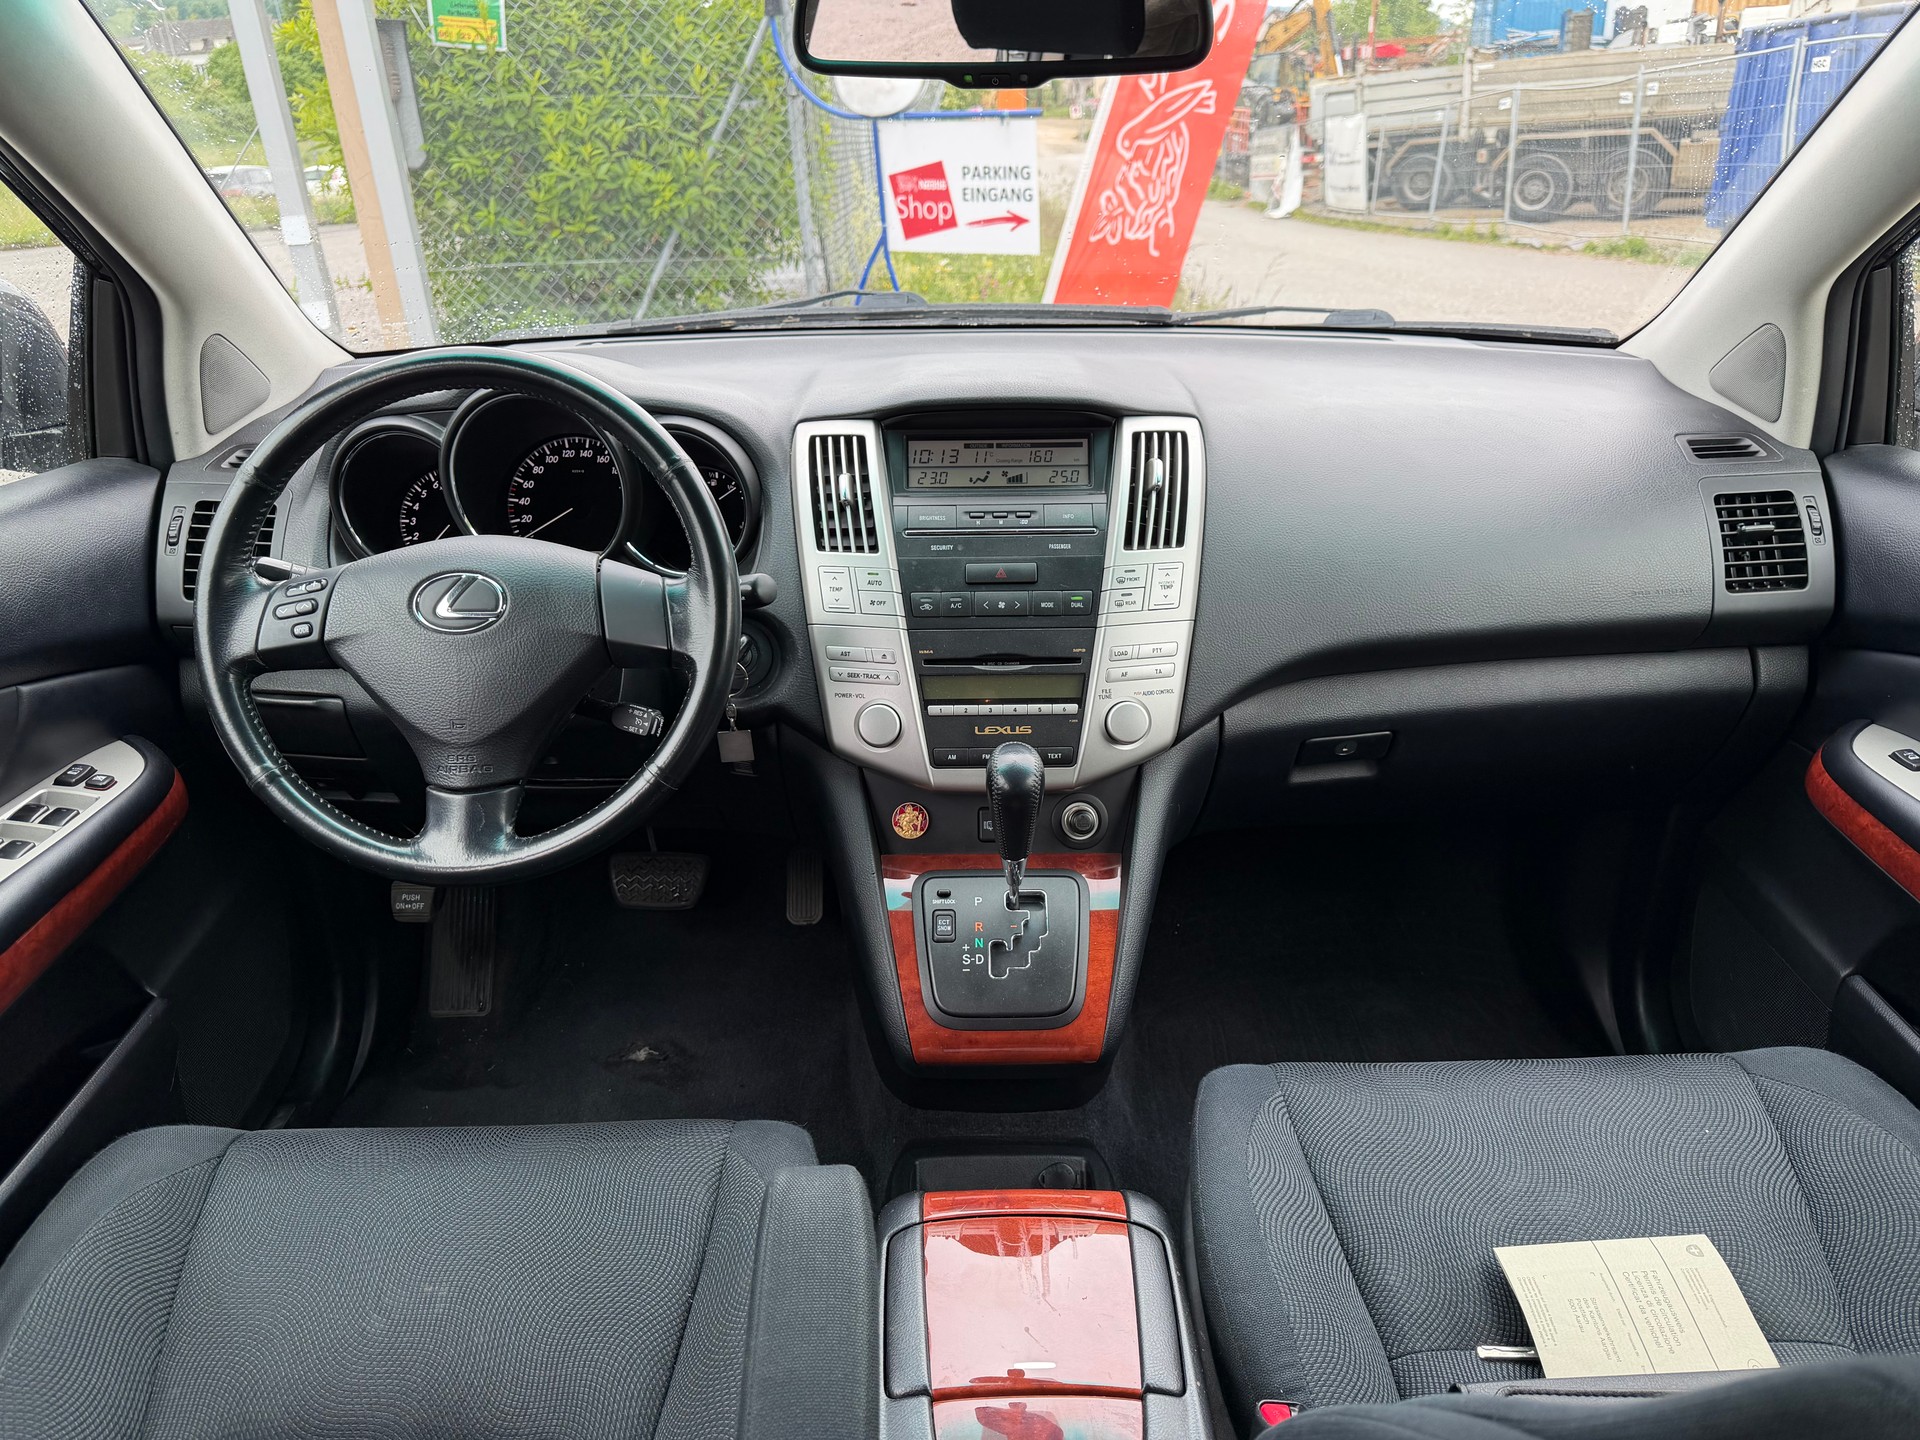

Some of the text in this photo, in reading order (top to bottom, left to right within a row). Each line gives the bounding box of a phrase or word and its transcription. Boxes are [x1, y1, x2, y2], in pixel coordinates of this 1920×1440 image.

[962, 166, 1031, 180] PARKING
[962, 188, 1034, 202] EINGANG
[895, 194, 953, 226] Shop
[562, 449, 576, 458] 120
[580, 449, 593, 458] 140
[912, 449, 960, 464] 10:13
[1028, 449, 1054, 463] 160
[545, 455, 559, 464] 100
[596, 455, 610, 464] 160
[532, 466, 544, 474] 80
[432, 480, 439, 489] 6
[522, 480, 534, 489] 60
[420, 489, 427, 498] 5
[518, 497, 531, 506] 40
[412, 502, 420, 511] 4
[410, 517, 417, 526] 3
[521, 514, 532, 523] 20
[412, 532, 420, 541] 2
[974, 725, 1033, 735] LEXUS
[436, 764, 494, 774] AIRBAG
[402, 893, 421, 901] PUSH
[974, 896, 983, 906] P
[395, 902, 425, 910] ON OFF
[975, 922, 984, 932] R
[975, 938, 984, 948] N
[1567, 1299, 1578, 1313] 5001
[1650, 1269, 1686, 1334] Fahrzeugausweis
[1622, 1271, 1643, 1303] Certificat
[1644, 1316, 1665, 1349] vehichel
[1631, 1270, 1649, 1299] Licenza
[1650, 1309, 1676, 1355] circolazione
[1641, 1270, 1682, 1347] Permis de circulation
